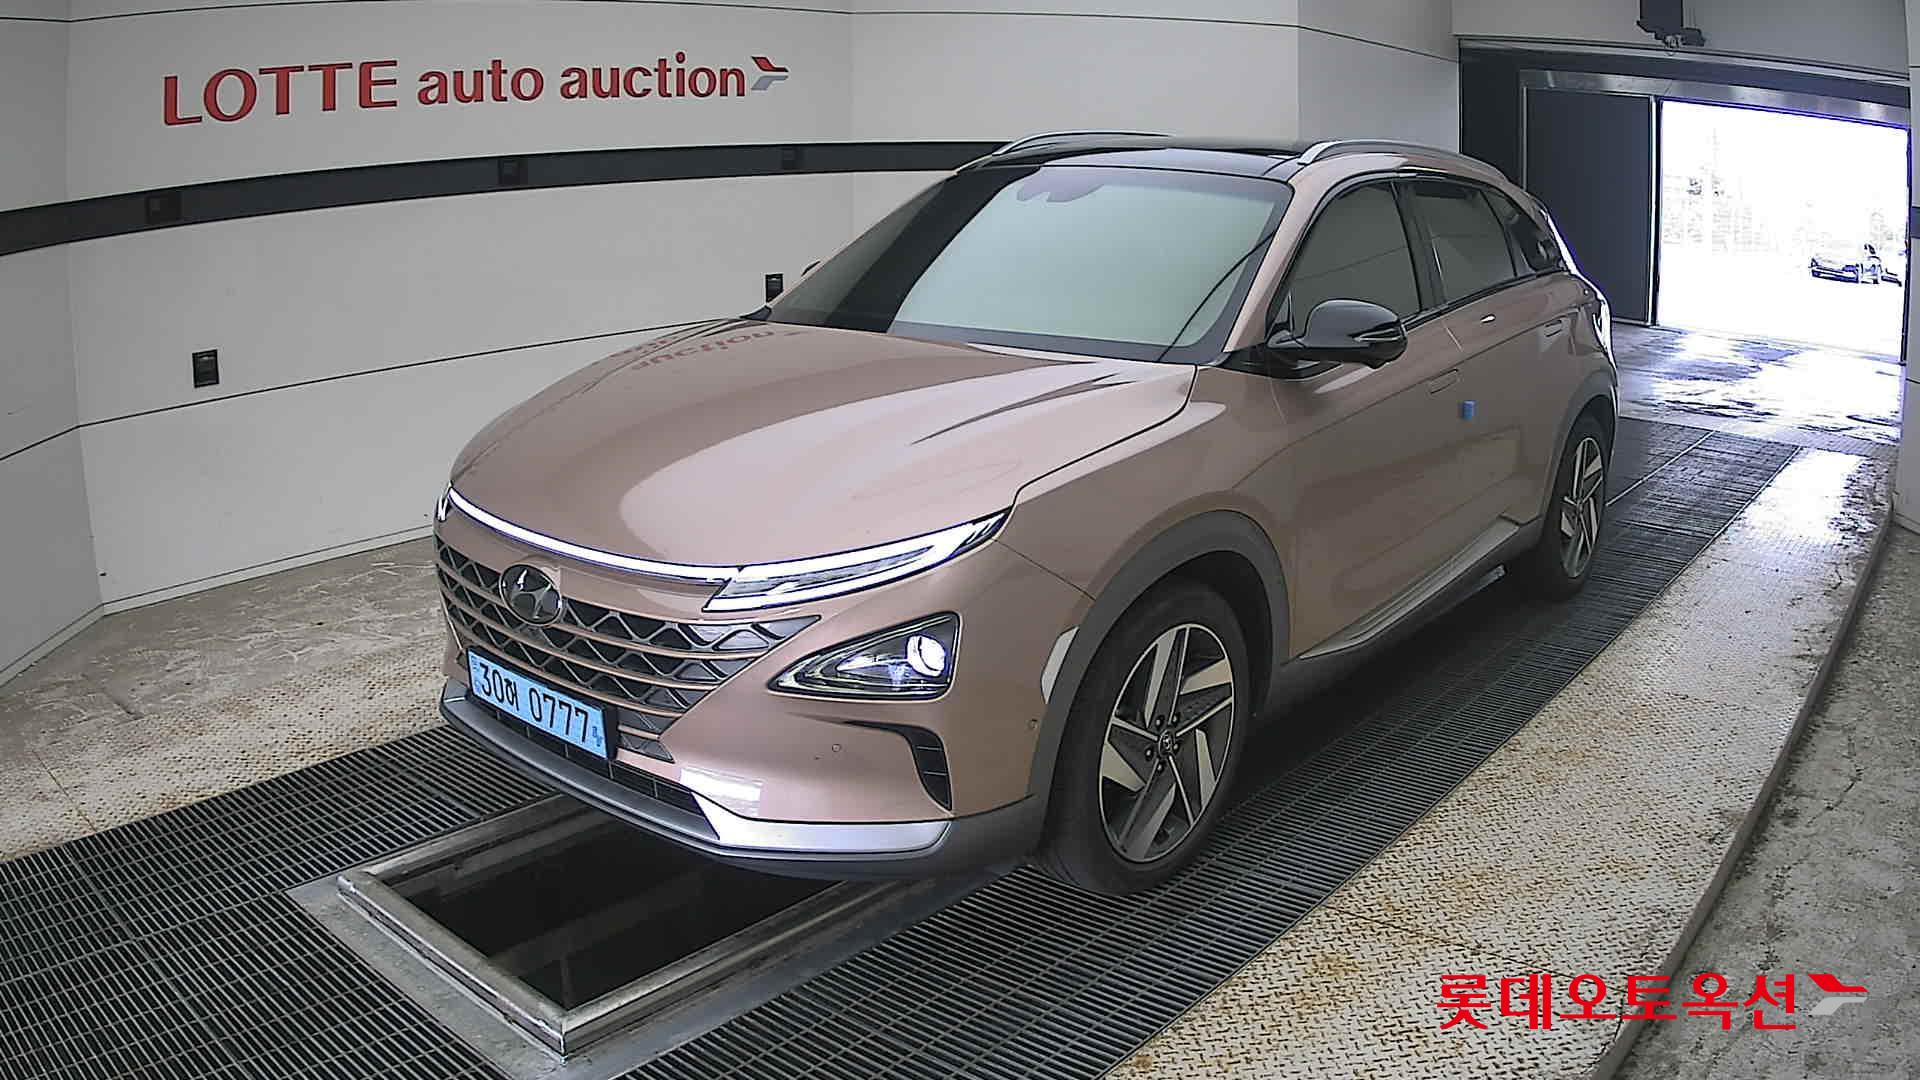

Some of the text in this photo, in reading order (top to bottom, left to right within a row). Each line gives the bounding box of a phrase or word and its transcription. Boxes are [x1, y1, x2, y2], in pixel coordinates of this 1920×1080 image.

[163, 51, 747, 126] LOTTE auto auction
[528, 687, 589, 743] 0777
